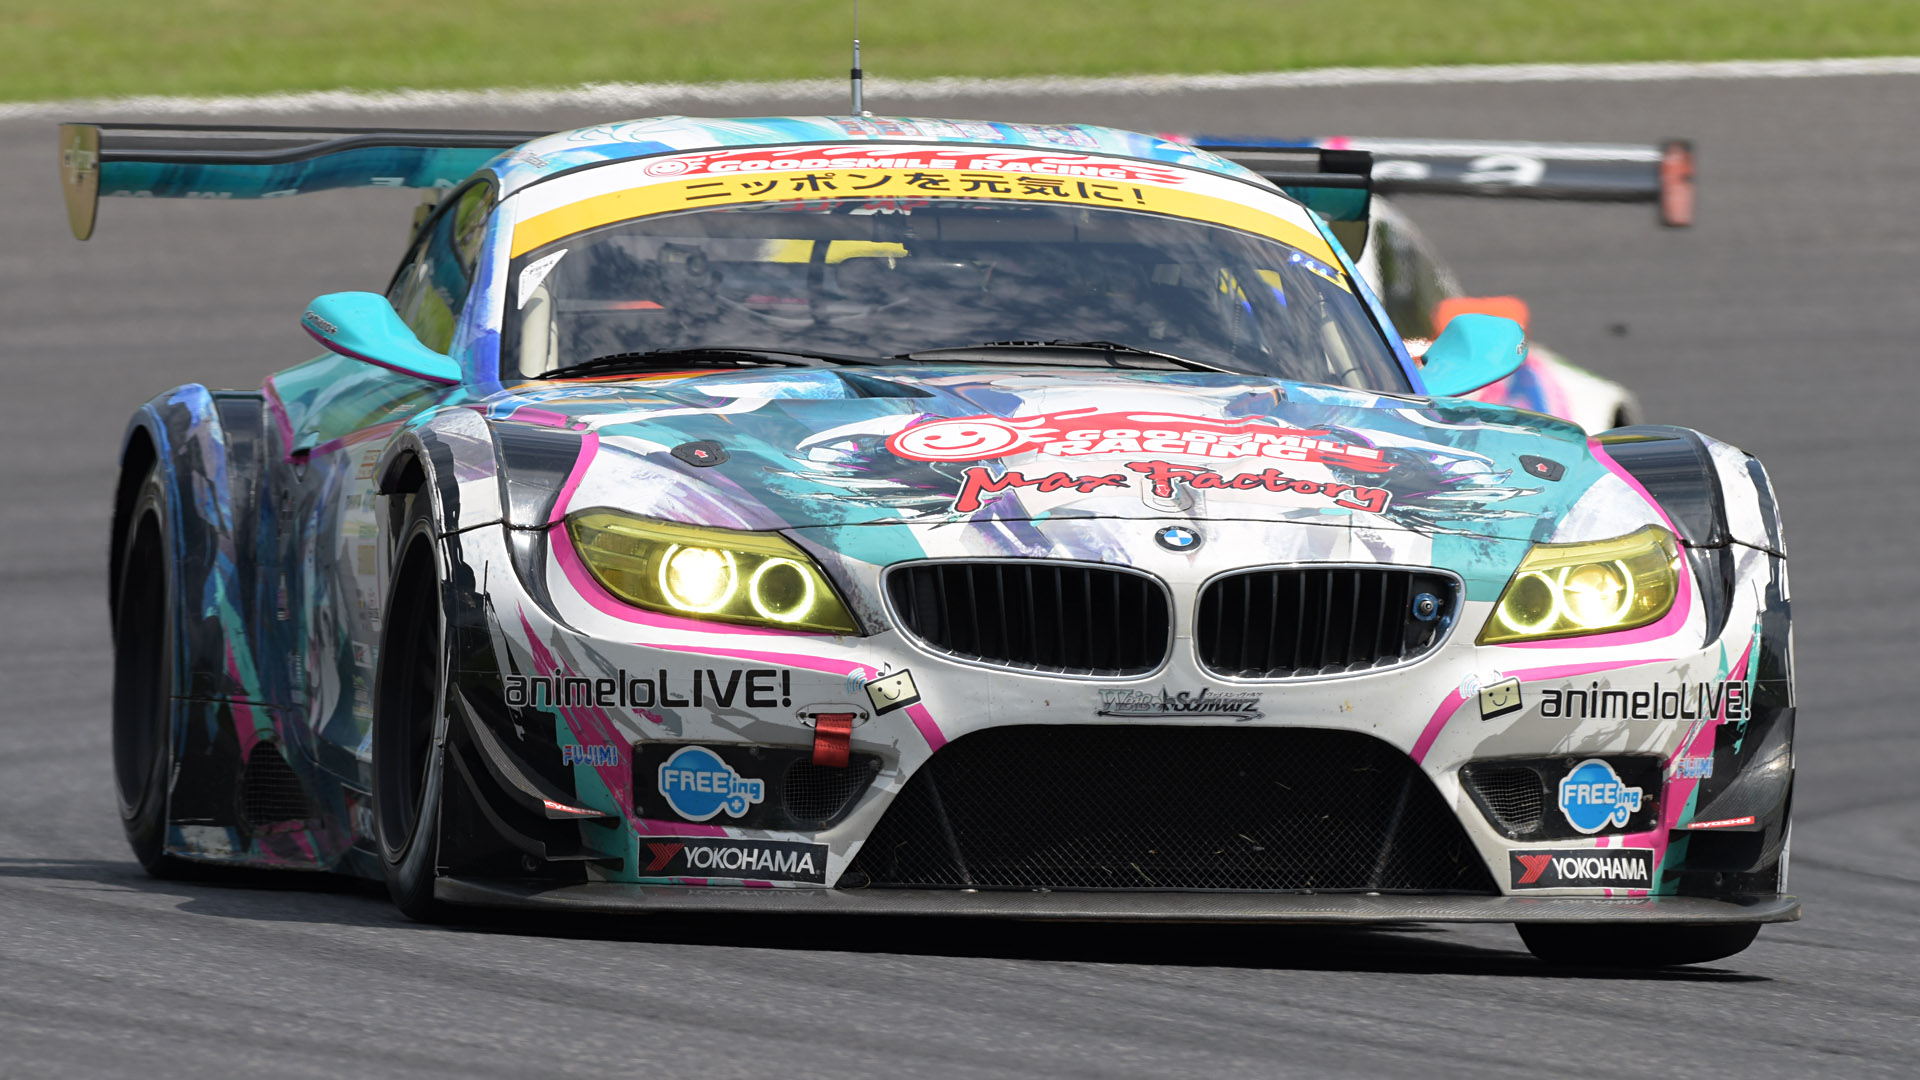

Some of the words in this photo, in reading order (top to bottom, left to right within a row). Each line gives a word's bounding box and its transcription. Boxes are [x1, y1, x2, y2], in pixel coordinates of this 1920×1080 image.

[707, 158, 957, 172] GOODSMILE
[969, 158, 1127, 179] RACING
[685, 172, 1147, 205] ニッポンを元気に!
[1042, 438, 1308, 461] RACING
[1064, 428, 1381, 460] GOODSMILE
[954, 466, 1131, 513] Max
[1123, 459, 1391, 514] Factory
[504, 668, 793, 709] animeloLIVE!
[1172, 687, 1261, 713] Schwarz
[1540, 680, 1752, 721] animeloLIVE!
[562, 745, 619, 767] FUJIMI
[664, 769, 761, 800] FREEing
[1562, 782, 1640, 808] FREEing
[1690, 817, 1752, 828] KYOSHO
[683, 846, 816, 875] YOKOHAMA
[1551, 856, 1649, 881] YOKOHAMA
